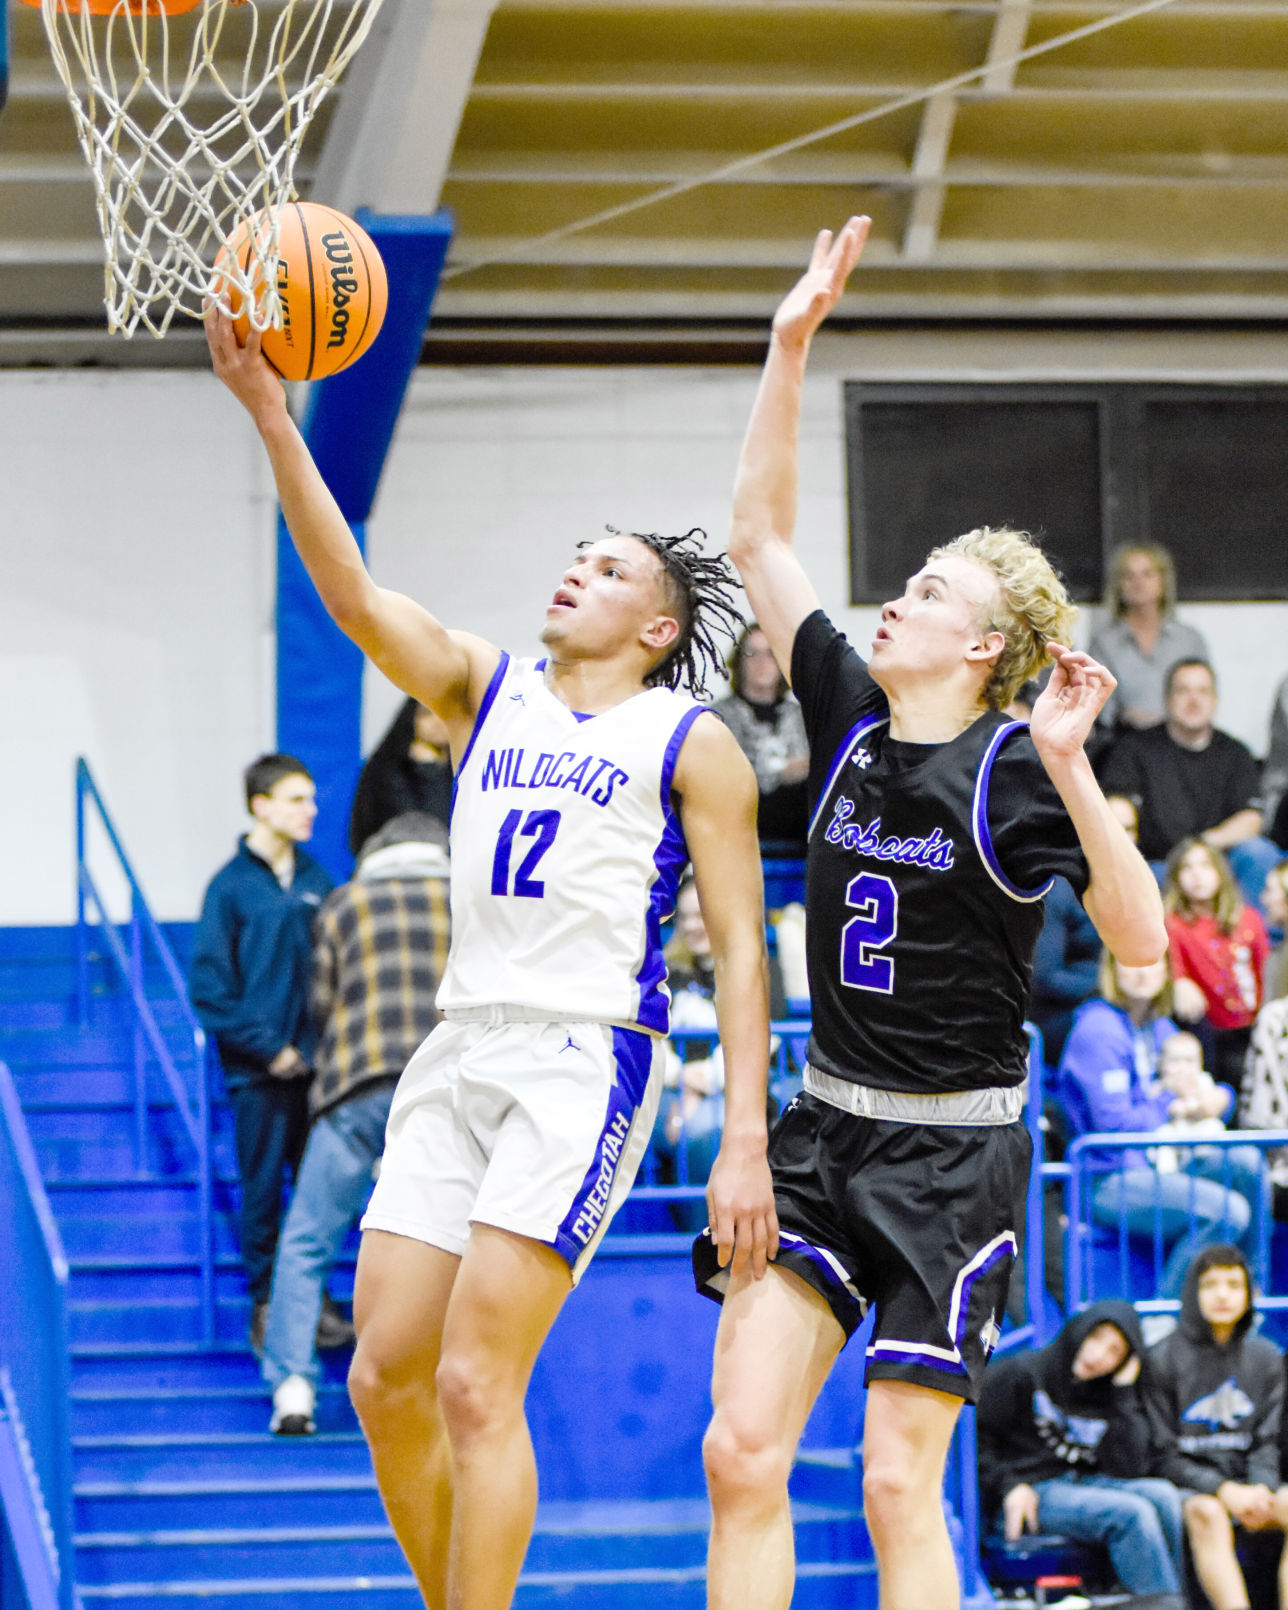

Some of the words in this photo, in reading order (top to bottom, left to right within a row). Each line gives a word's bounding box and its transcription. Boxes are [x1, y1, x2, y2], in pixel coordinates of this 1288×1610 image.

[320, 230, 358, 349] Wilson
[481, 748, 630, 807] WILDCATS
[491, 809, 561, 898] 12
[824, 795, 954, 871] Bobcats
[840, 871, 899, 994] 2
[572, 1111, 630, 1245] CHECOTAH
